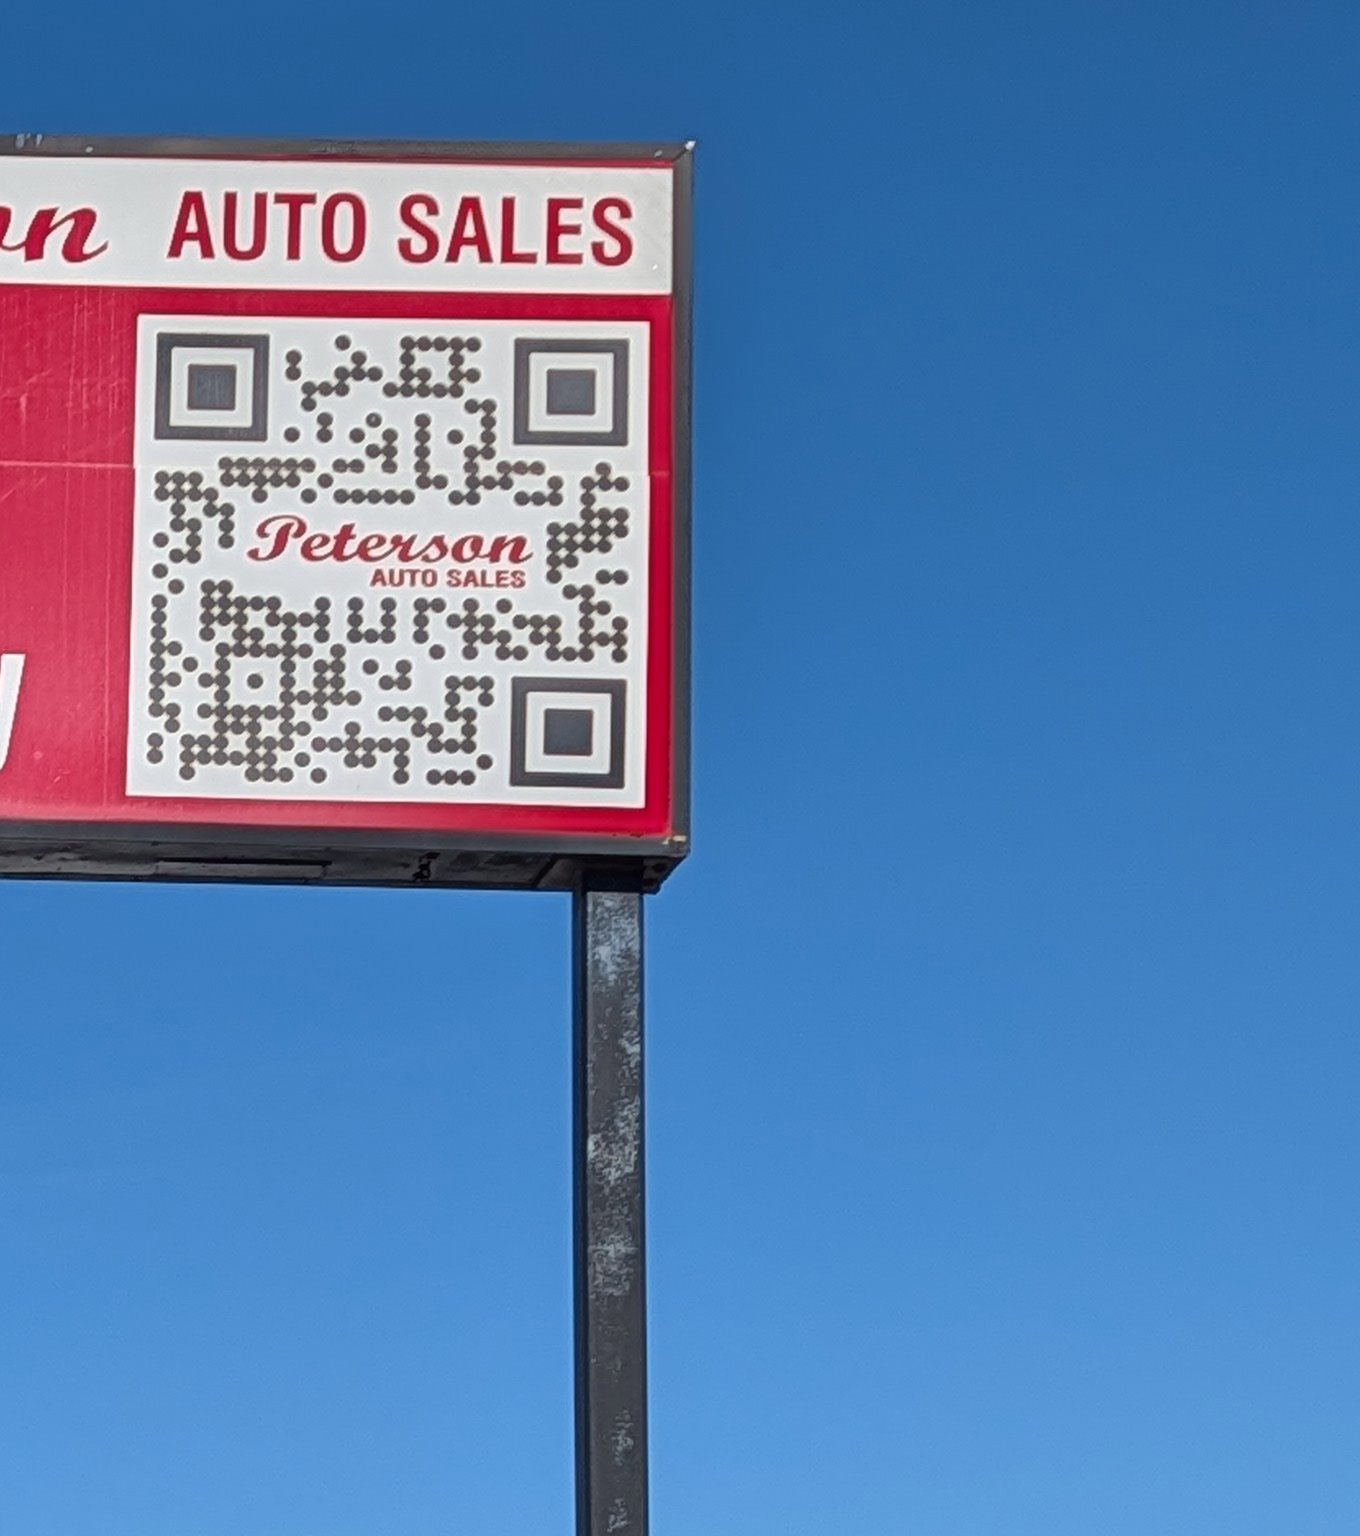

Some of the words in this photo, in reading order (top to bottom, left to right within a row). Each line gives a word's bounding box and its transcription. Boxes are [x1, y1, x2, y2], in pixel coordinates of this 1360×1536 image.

[166, 190, 367, 262] AUTO
[397, 193, 635, 266] SALES
[246, 514, 534, 563] Peterson
[369, 568, 438, 587] AUTO
[445, 568, 527, 588] SALES
